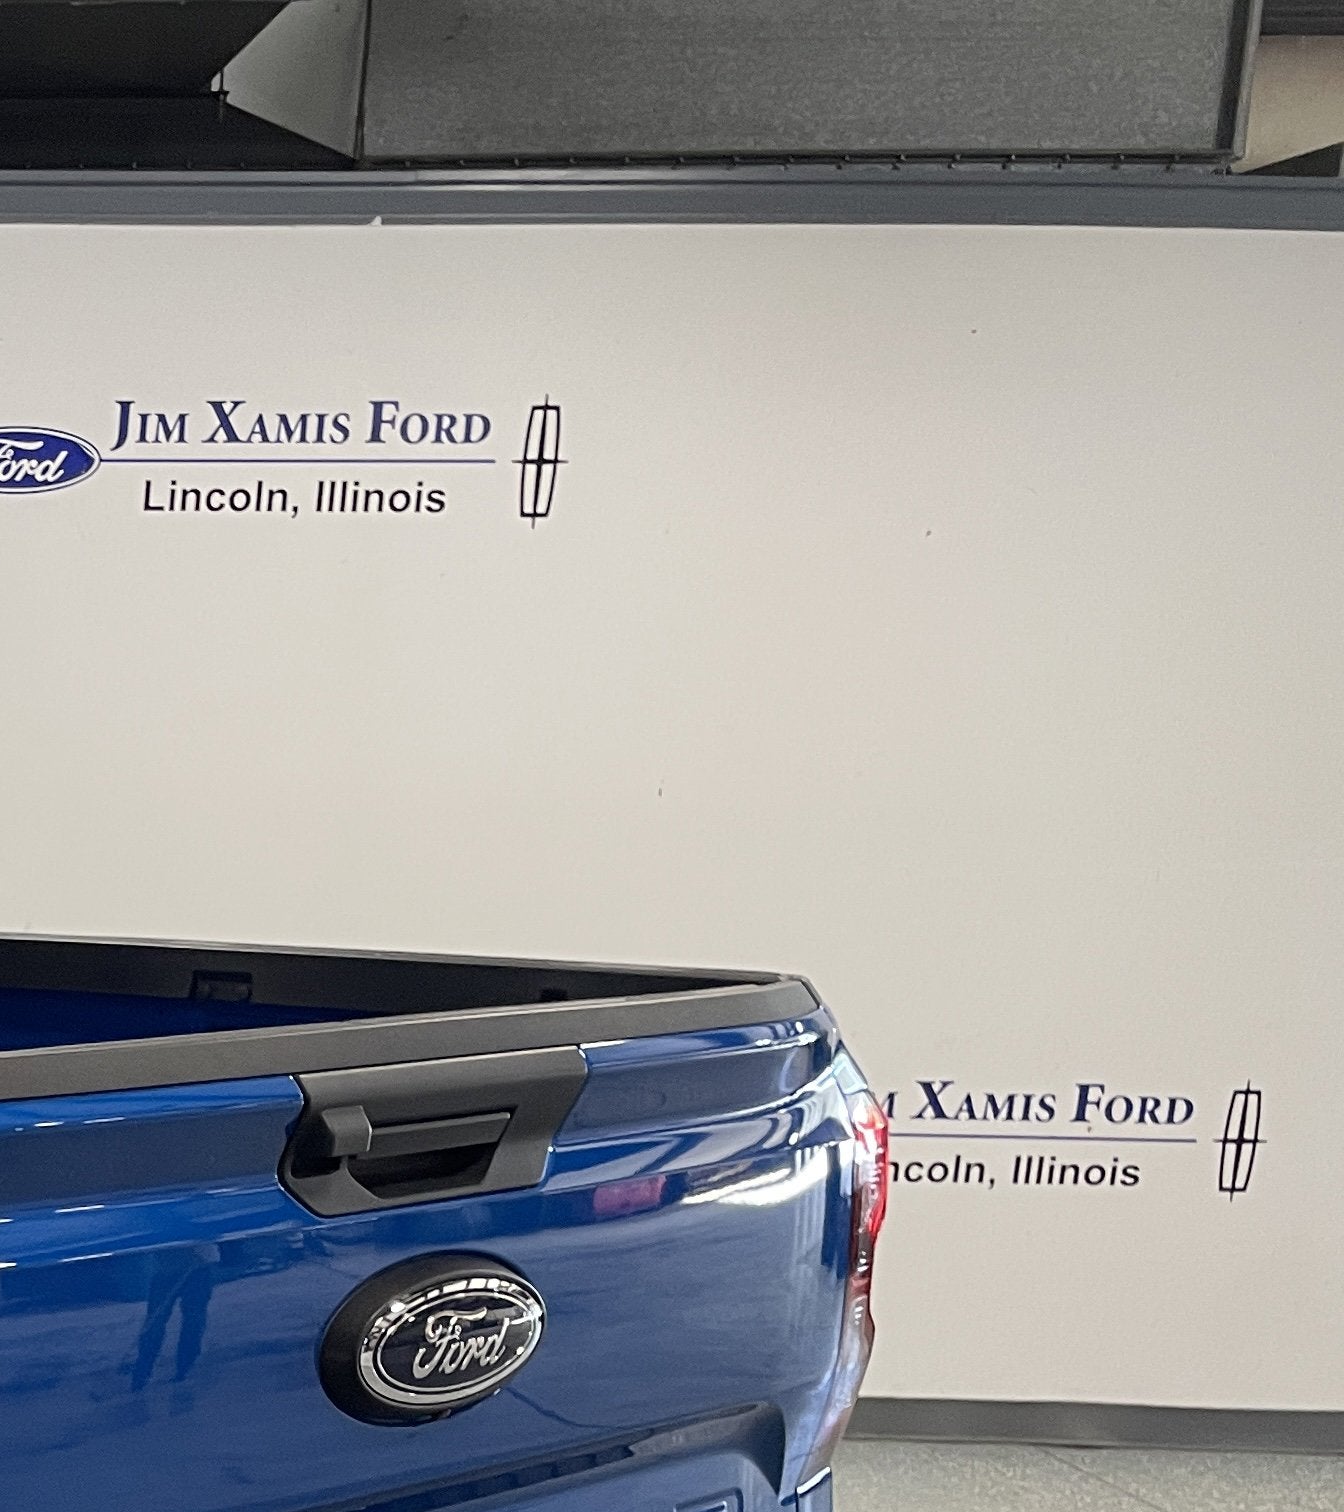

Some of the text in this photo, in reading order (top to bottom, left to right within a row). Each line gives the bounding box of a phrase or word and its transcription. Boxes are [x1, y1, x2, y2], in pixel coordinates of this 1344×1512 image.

[110, 400, 491, 451] JIM XAMIS FORD
[143, 479, 446, 518] Lincoln, Illinois
[911, 1080, 1056, 1122] XAMIS
[1070, 1083, 1194, 1126] FORD
[889, 1154, 1141, 1190] ncoln, Illinois
[412, 1307, 510, 1379] Ford
